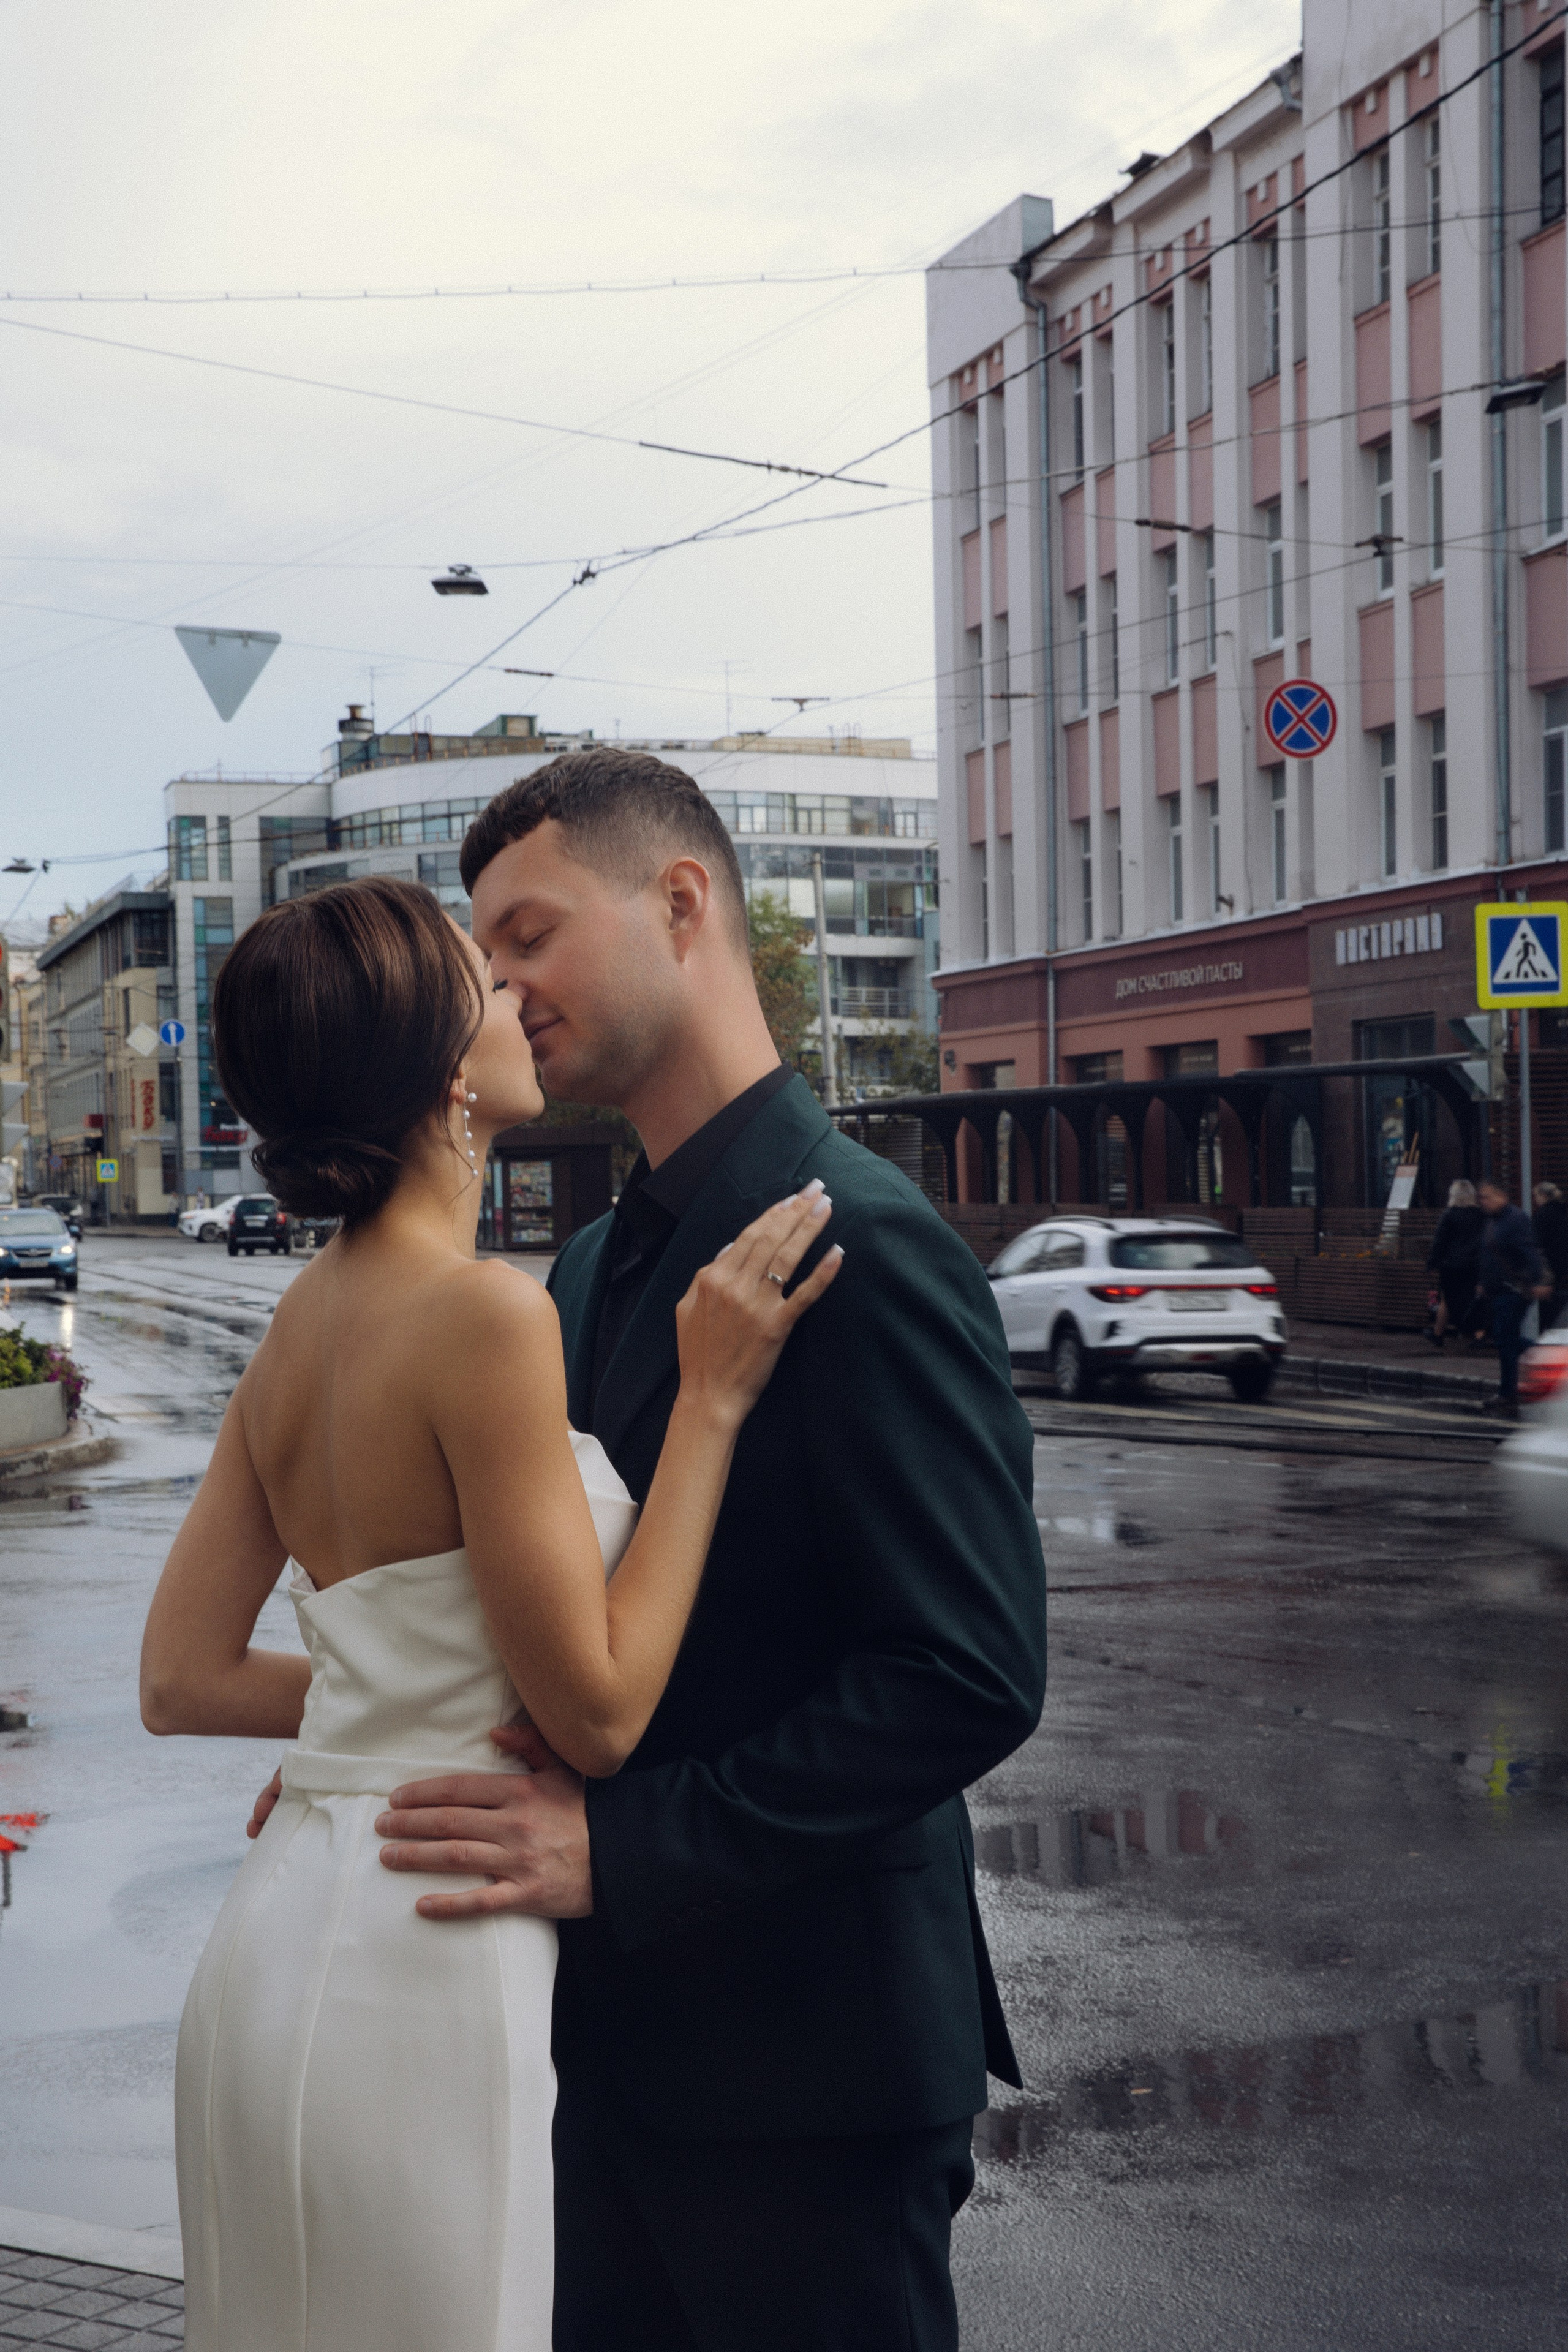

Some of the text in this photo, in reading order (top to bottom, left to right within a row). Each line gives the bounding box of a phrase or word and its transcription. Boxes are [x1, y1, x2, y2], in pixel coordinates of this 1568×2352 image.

[1115, 961, 1243, 999] ДОМ СЧАСТЛИВОЙ ПАСТЫ
